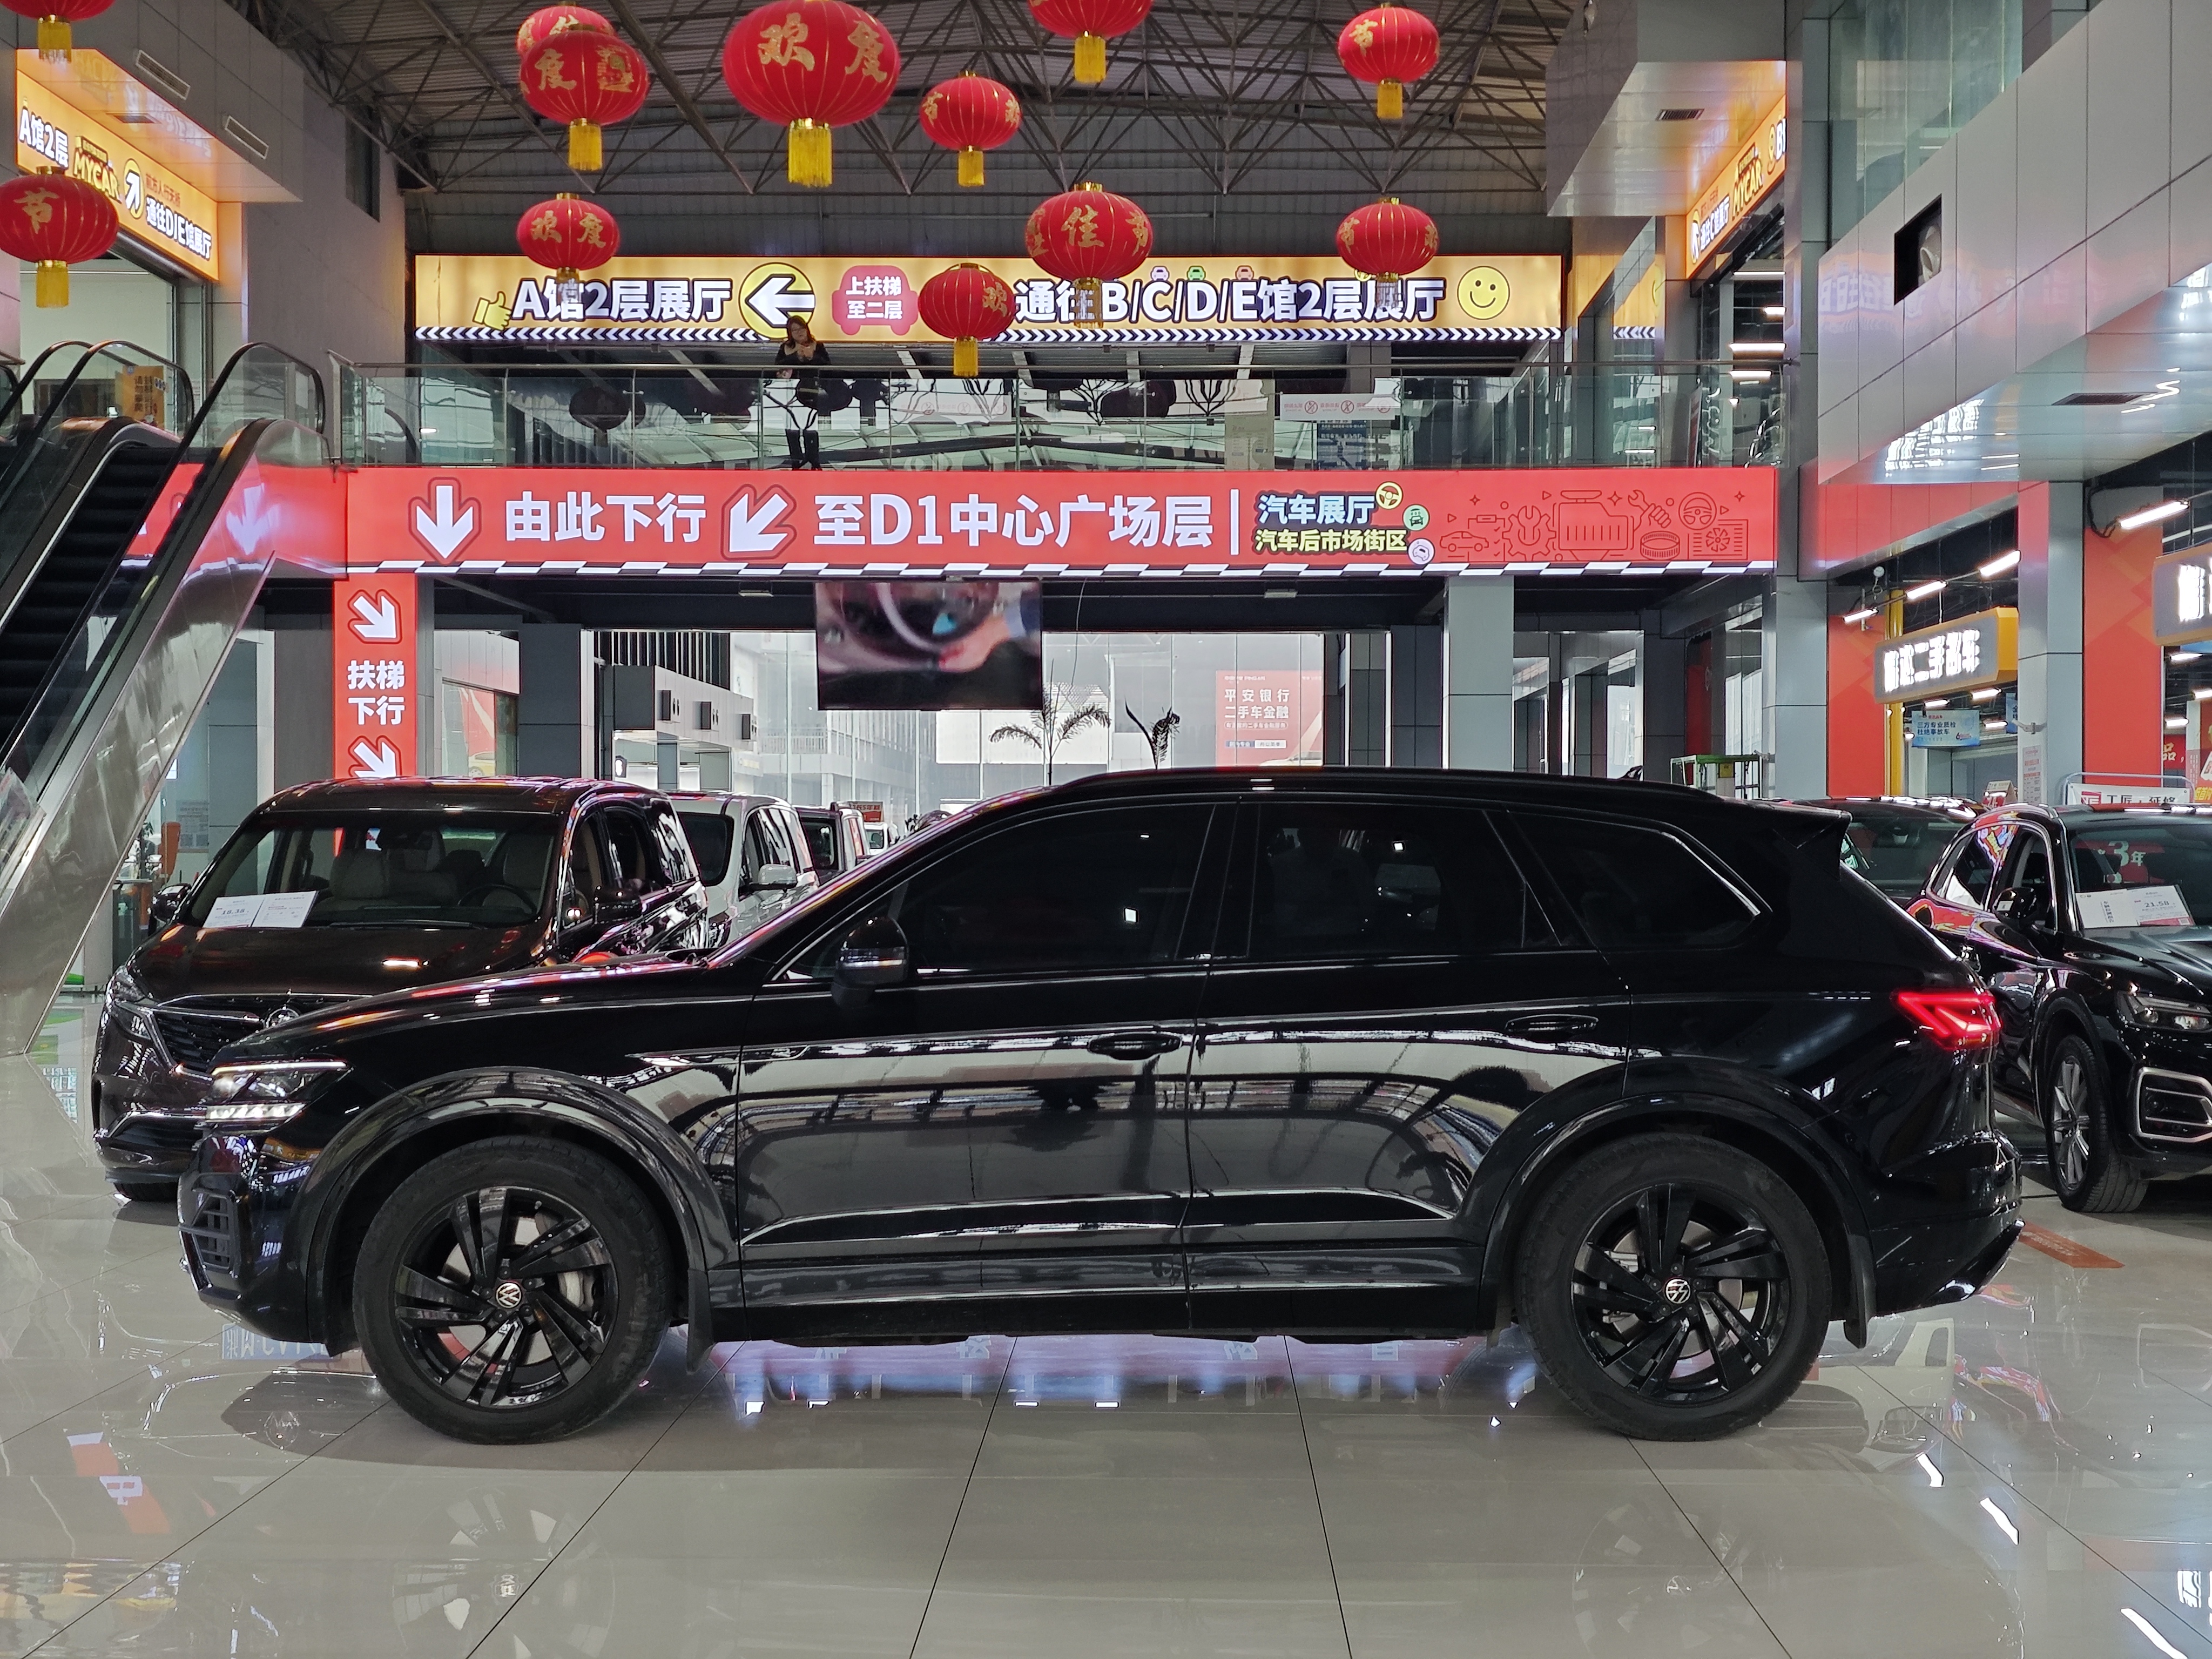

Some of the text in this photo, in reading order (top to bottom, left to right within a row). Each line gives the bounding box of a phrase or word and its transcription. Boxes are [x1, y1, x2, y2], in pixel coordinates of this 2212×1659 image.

[846, 275, 902, 296] 上扶梯
[512, 279, 732, 321] A馆2层展厅
[847, 300, 903, 320] 至二层
[505, 490, 1213, 548] 由此下行 至D1中心广场层
[1258, 494, 1375, 525] 汽车展厅
[1255, 530, 1407, 552] 汽车后市场街区
[347, 660, 405, 690] 扶梯
[1224, 689, 1290, 703] 平安银行
[348, 696, 405, 726] 下行
[1224, 705, 1290, 719] 二手车金融
